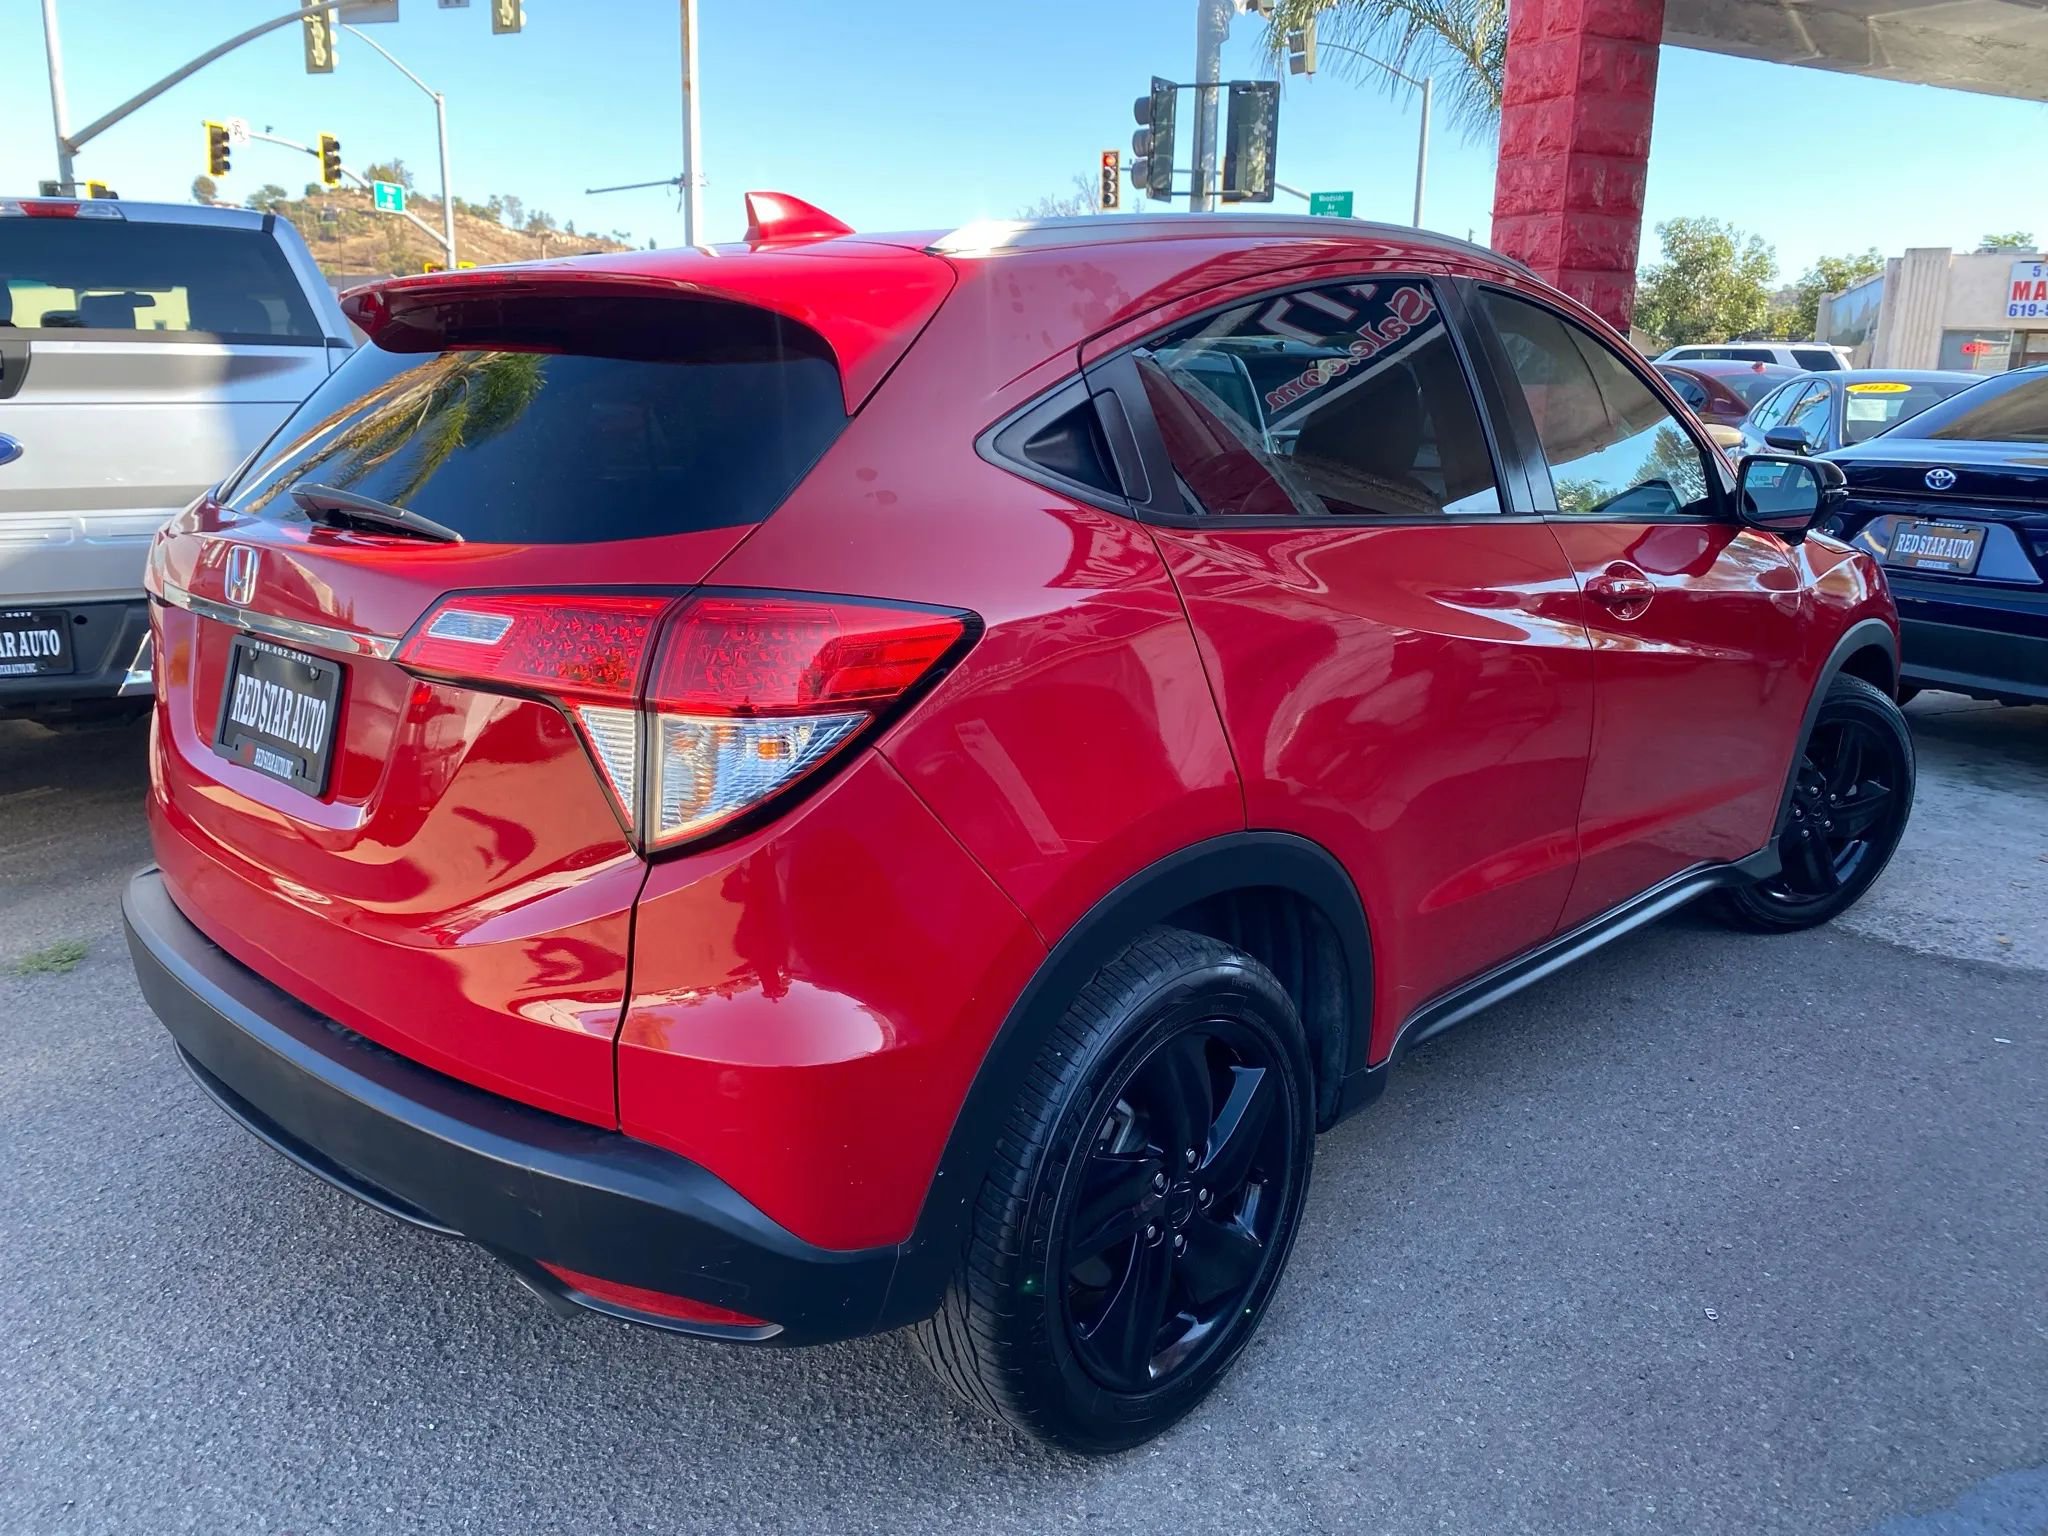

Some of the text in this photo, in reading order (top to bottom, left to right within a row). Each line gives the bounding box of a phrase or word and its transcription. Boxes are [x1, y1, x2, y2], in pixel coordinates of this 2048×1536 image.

[1895, 533, 1975, 560] RED STAR AUTO
[19, 629, 61, 657] AUTO
[231, 673, 327, 754] RED STAR AUTO
